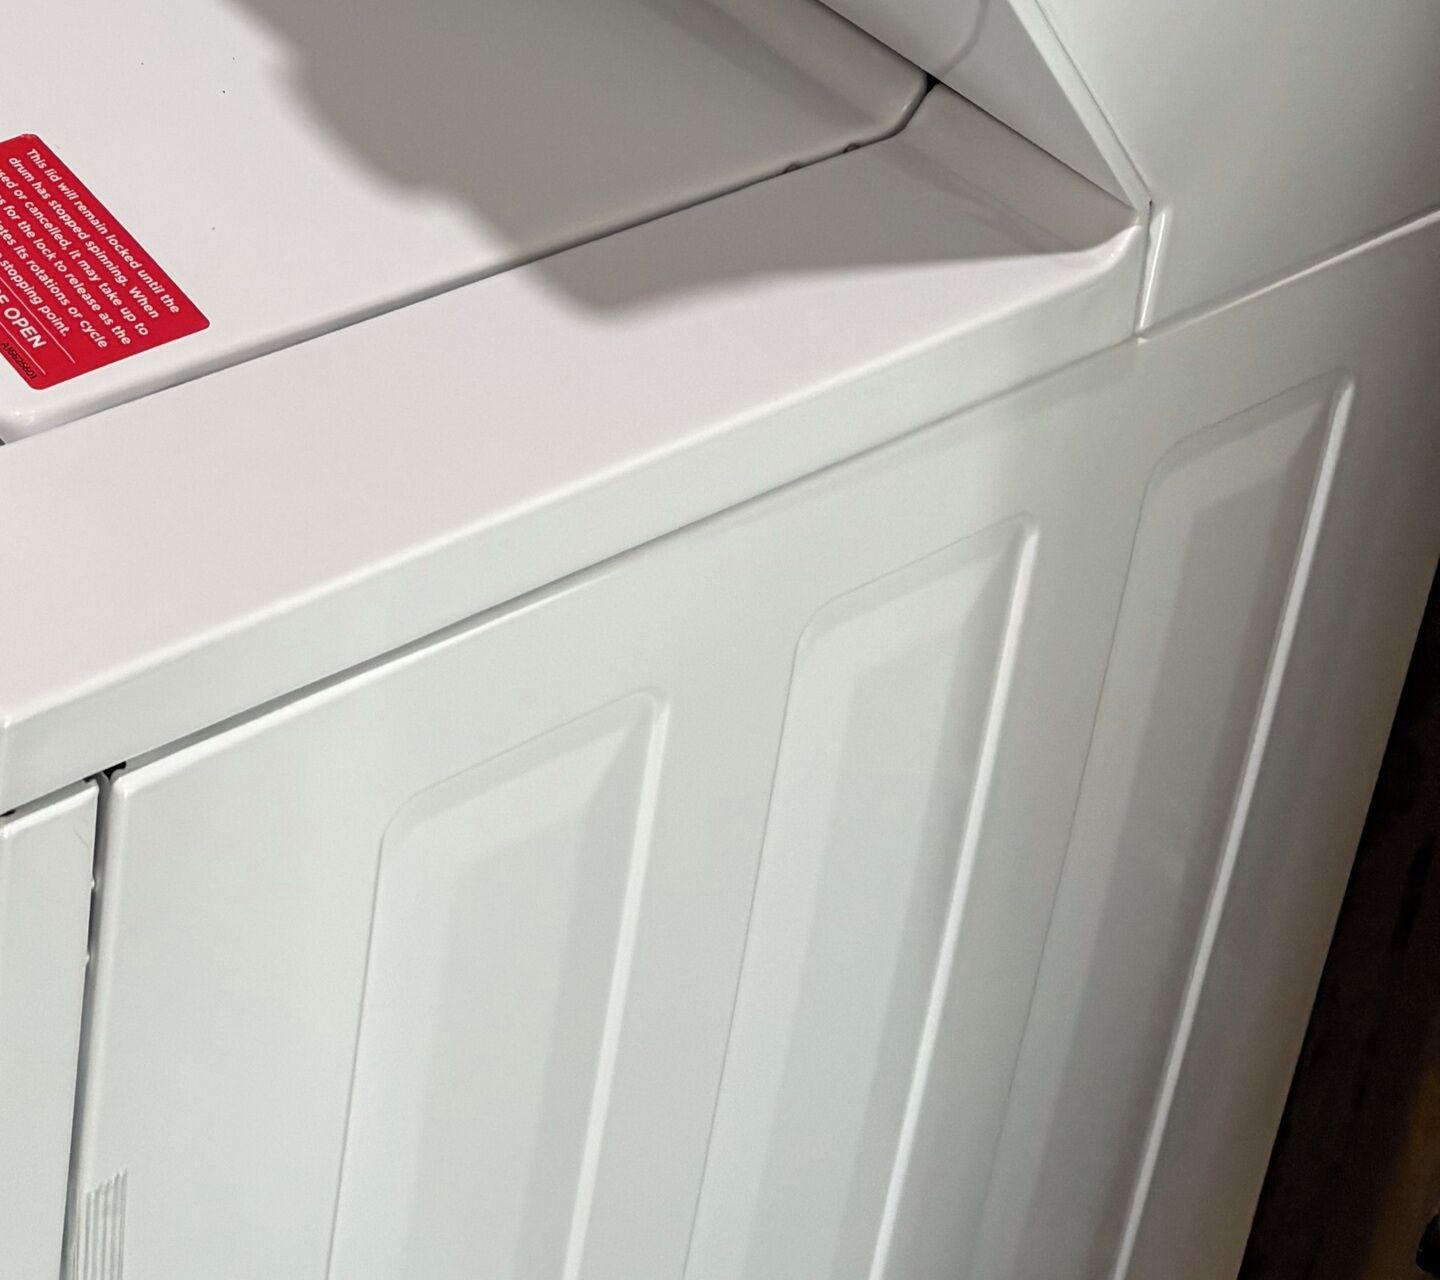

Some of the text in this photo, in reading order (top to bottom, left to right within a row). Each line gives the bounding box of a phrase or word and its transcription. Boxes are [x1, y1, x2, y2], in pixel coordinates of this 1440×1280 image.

[0, 260, 44, 306] stopping
[37, 305, 71, 337] point.
[3, 205, 21, 220] for
[17, 220, 36, 239] the
[32, 238, 57, 261] lock
[54, 260, 67, 273] to
[65, 273, 101, 312] release
[99, 312, 113, 326] as
[111, 325, 131, 345] the
[9, 157, 160, 319] drum has stopped spinning. When
[13, 189, 28, 201] or
[24, 201, 72, 250] cancelled,
[68, 249, 81, 260] it
[77, 260, 102, 282] may
[98, 282, 123, 307] take
[120, 307, 137, 322] up
[134, 322, 149, 336] to
[13, 245, 29, 260] its
[26, 260, 71, 306] rotations
[68, 306, 83, 319] or
[80, 320, 108, 348] cycle
[27, 148, 180, 313] This lid will remain locked until the
[3, 307, 47, 349] OPEN
